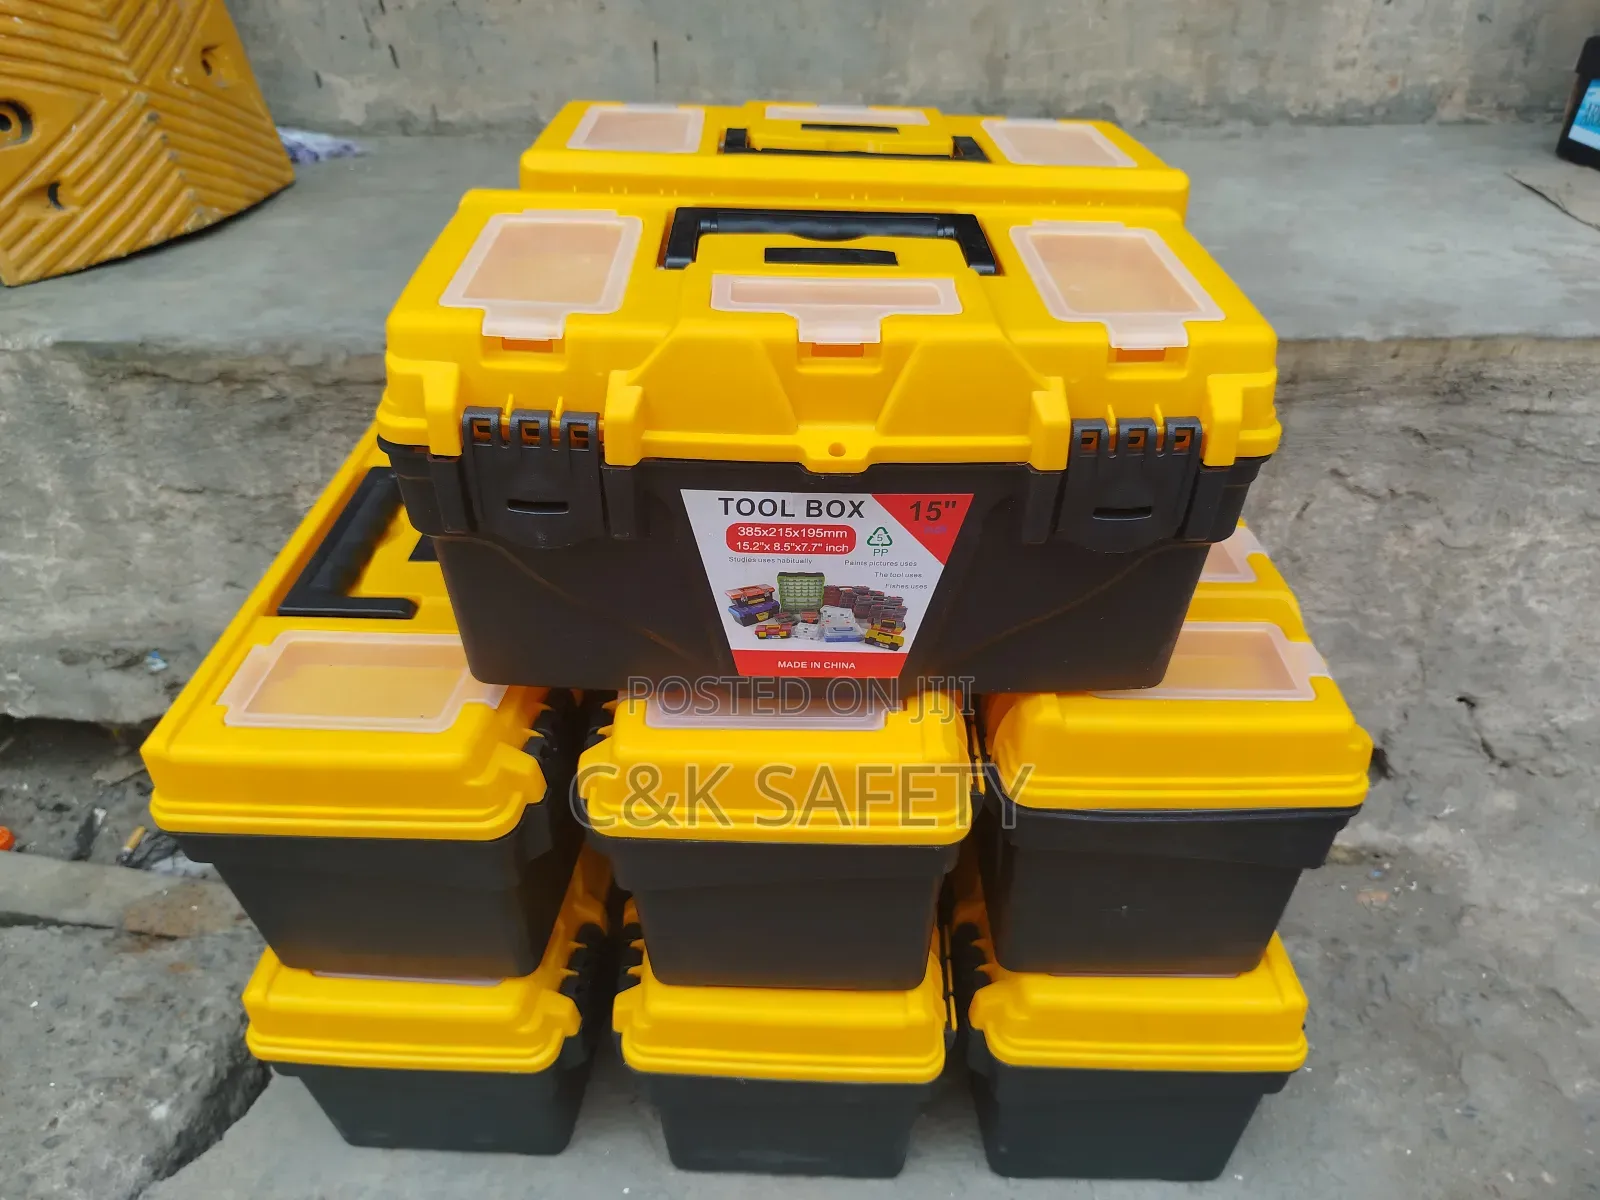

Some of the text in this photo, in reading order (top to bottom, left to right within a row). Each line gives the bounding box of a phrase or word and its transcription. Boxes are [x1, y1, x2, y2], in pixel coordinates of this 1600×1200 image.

[718, 497, 865, 519] TOOL BOX
[909, 500, 957, 522] 15"
[737, 526, 848, 539] 385x215x195mm
[876, 534, 883, 542] 5
[825, 544, 849, 553] inch
[873, 549, 888, 557] PP
[777, 660, 856, 670] MADE IN CHINA
